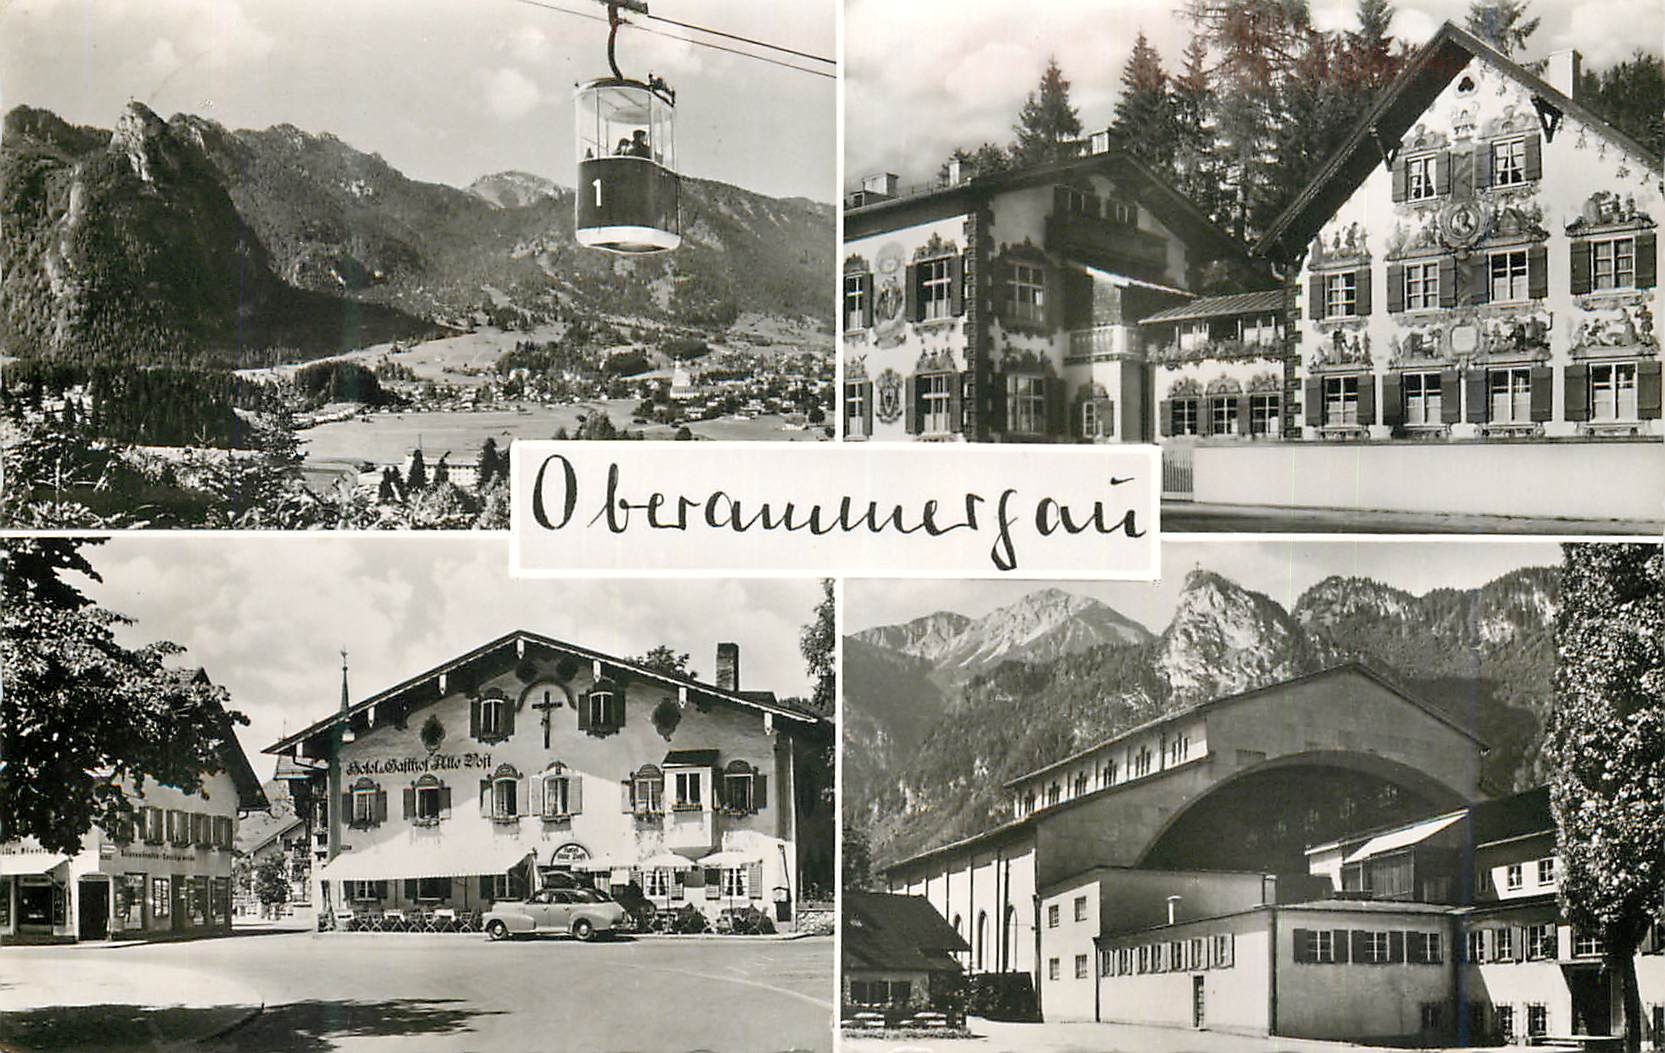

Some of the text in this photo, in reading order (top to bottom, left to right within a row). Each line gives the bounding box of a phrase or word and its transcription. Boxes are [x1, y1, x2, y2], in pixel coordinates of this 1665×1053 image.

[591, 178, 602, 207] 1
[346, 759, 379, 776] Hotel
[384, 756, 429, 774] Gasthof
[430, 753, 461, 771] Alte
[463, 752, 492, 770] Post
